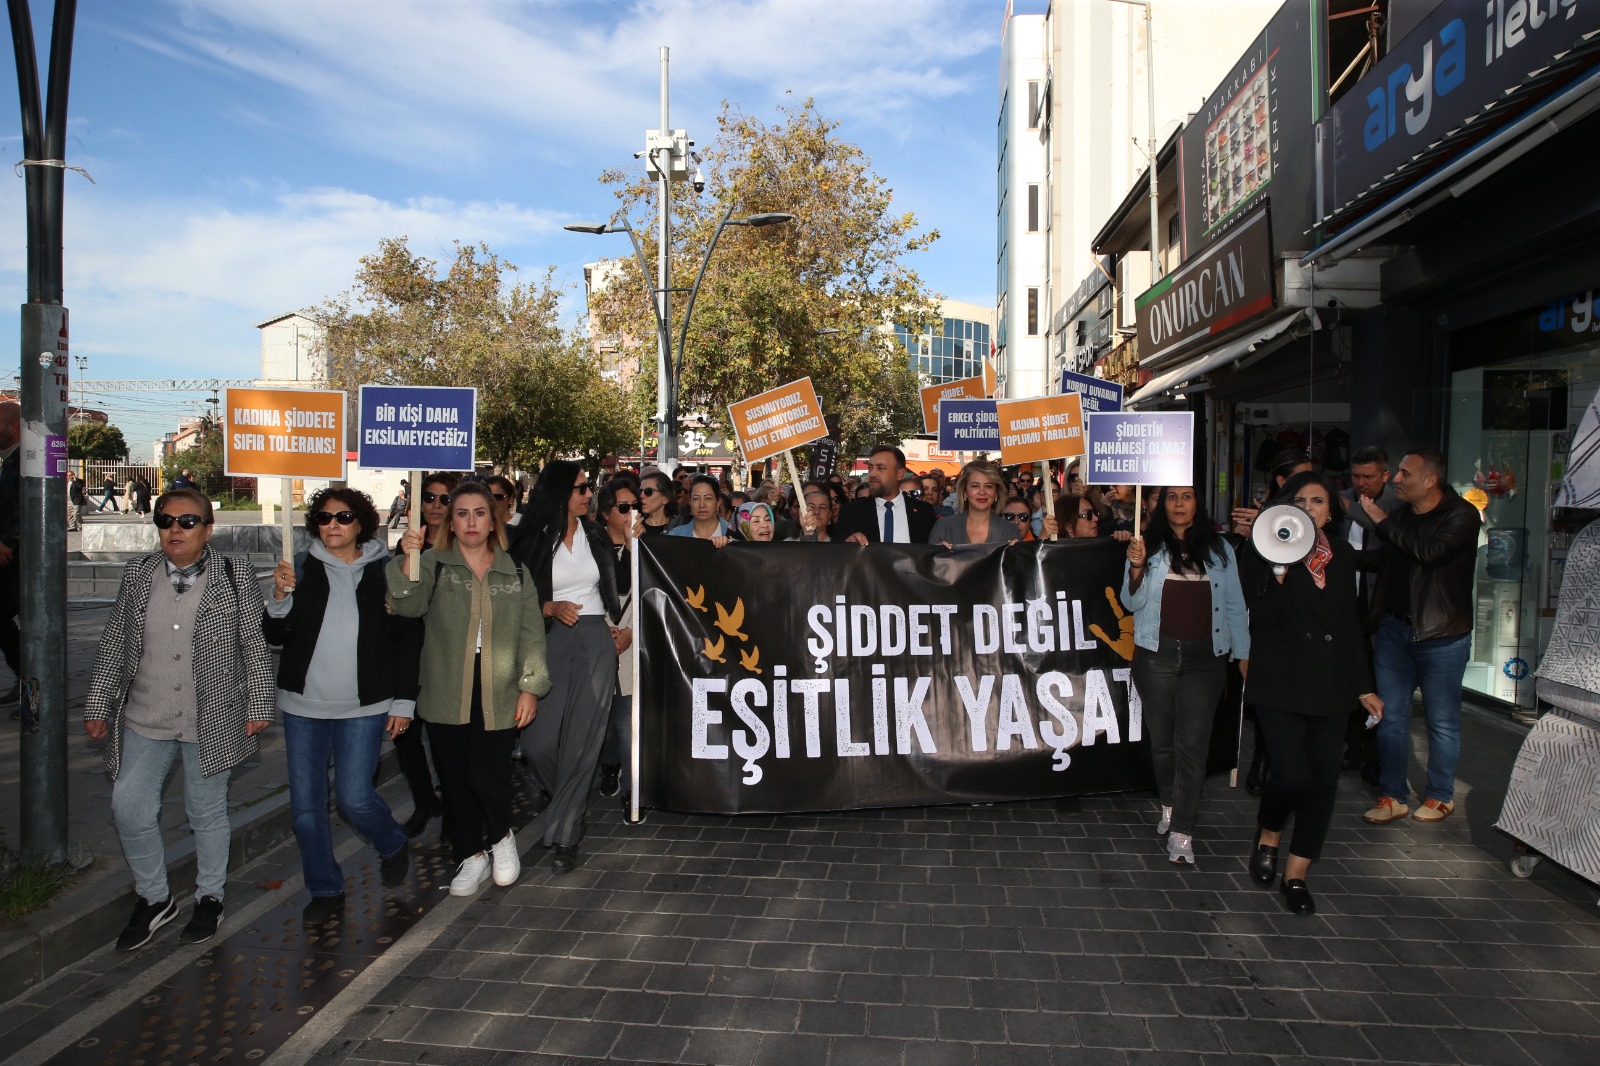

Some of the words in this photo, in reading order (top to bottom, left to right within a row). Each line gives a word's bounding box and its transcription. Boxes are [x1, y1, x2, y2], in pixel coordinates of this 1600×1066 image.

[1207, 49, 1262, 125] AYAKKABI
[1364, 18, 1466, 153] arya
[1150, 245, 1246, 346] ONURCAN
[1066, 379, 1088, 395] KORKU
[1089, 384, 1118, 402] DUVARINI
[376, 403, 396, 422] BİR
[399, 403, 423, 428] KİŞİ
[425, 407, 459, 424] DAHA
[745, 391, 802, 421] SUSMUYORUZ
[234, 408, 281, 427] KADINA
[284, 406, 336, 433] ŞİDDETE
[746, 404, 810, 436] KORKMUYORUZ
[948, 412, 974, 423] ERKEK
[975, 410, 998, 426] ŞİDDE
[1010, 416, 1041, 431] KADINA
[1042, 412, 1070, 430] ŞİDDET
[365, 426, 468, 447] EKSİLMEYECEĞİZ!
[744, 435, 769, 452] İTAAT
[770, 416, 821, 443] ETMİYORUZ!
[954, 426, 999, 439] POLİTİKTİR!
[1002, 431, 1041, 447] TOPLUMU
[1041, 426, 1080, 443] YARALAR!
[1116, 421, 1164, 441] ŞİDDETİN
[233, 433, 265, 451] SIFIR
[268, 435, 336, 455] TOLERANS!
[695, 448, 714, 456] AVM
[1093, 439, 1146, 455] BAHANESİ
[1148, 441, 1187, 455] OLMAZ
[1095, 456, 1139, 473] FAİLLERİ
[807, 594, 959, 675] ŞİDDET
[973, 590, 1098, 656] DEĞİL
[691, 664, 938, 786] EŞİTLİK
[954, 667, 1143, 772] YAŞAT
